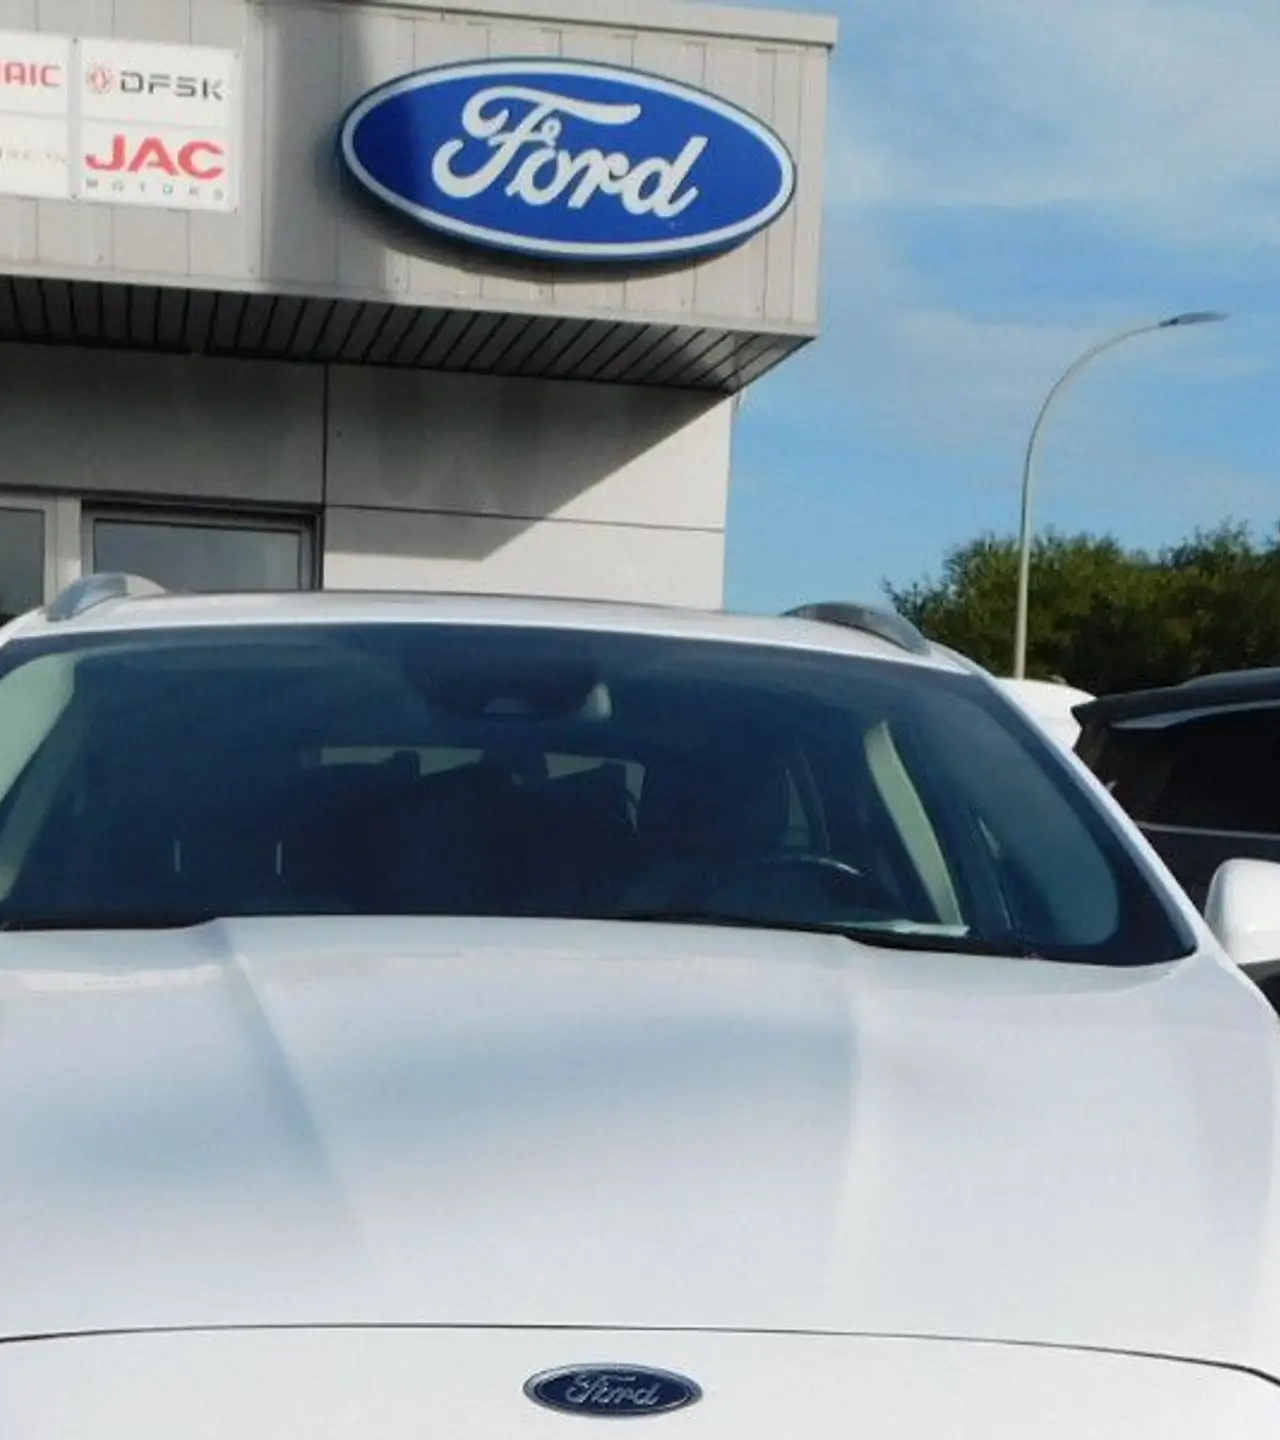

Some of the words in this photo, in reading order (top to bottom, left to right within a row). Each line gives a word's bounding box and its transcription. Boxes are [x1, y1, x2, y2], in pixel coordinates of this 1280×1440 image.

[120, 70, 223, 101] DFSK
[84, 133, 225, 181] JAC
[431, 84, 709, 219] Ford
[85, 178, 225, 201] MOTORS
[565, 1372, 661, 1406] Ford
